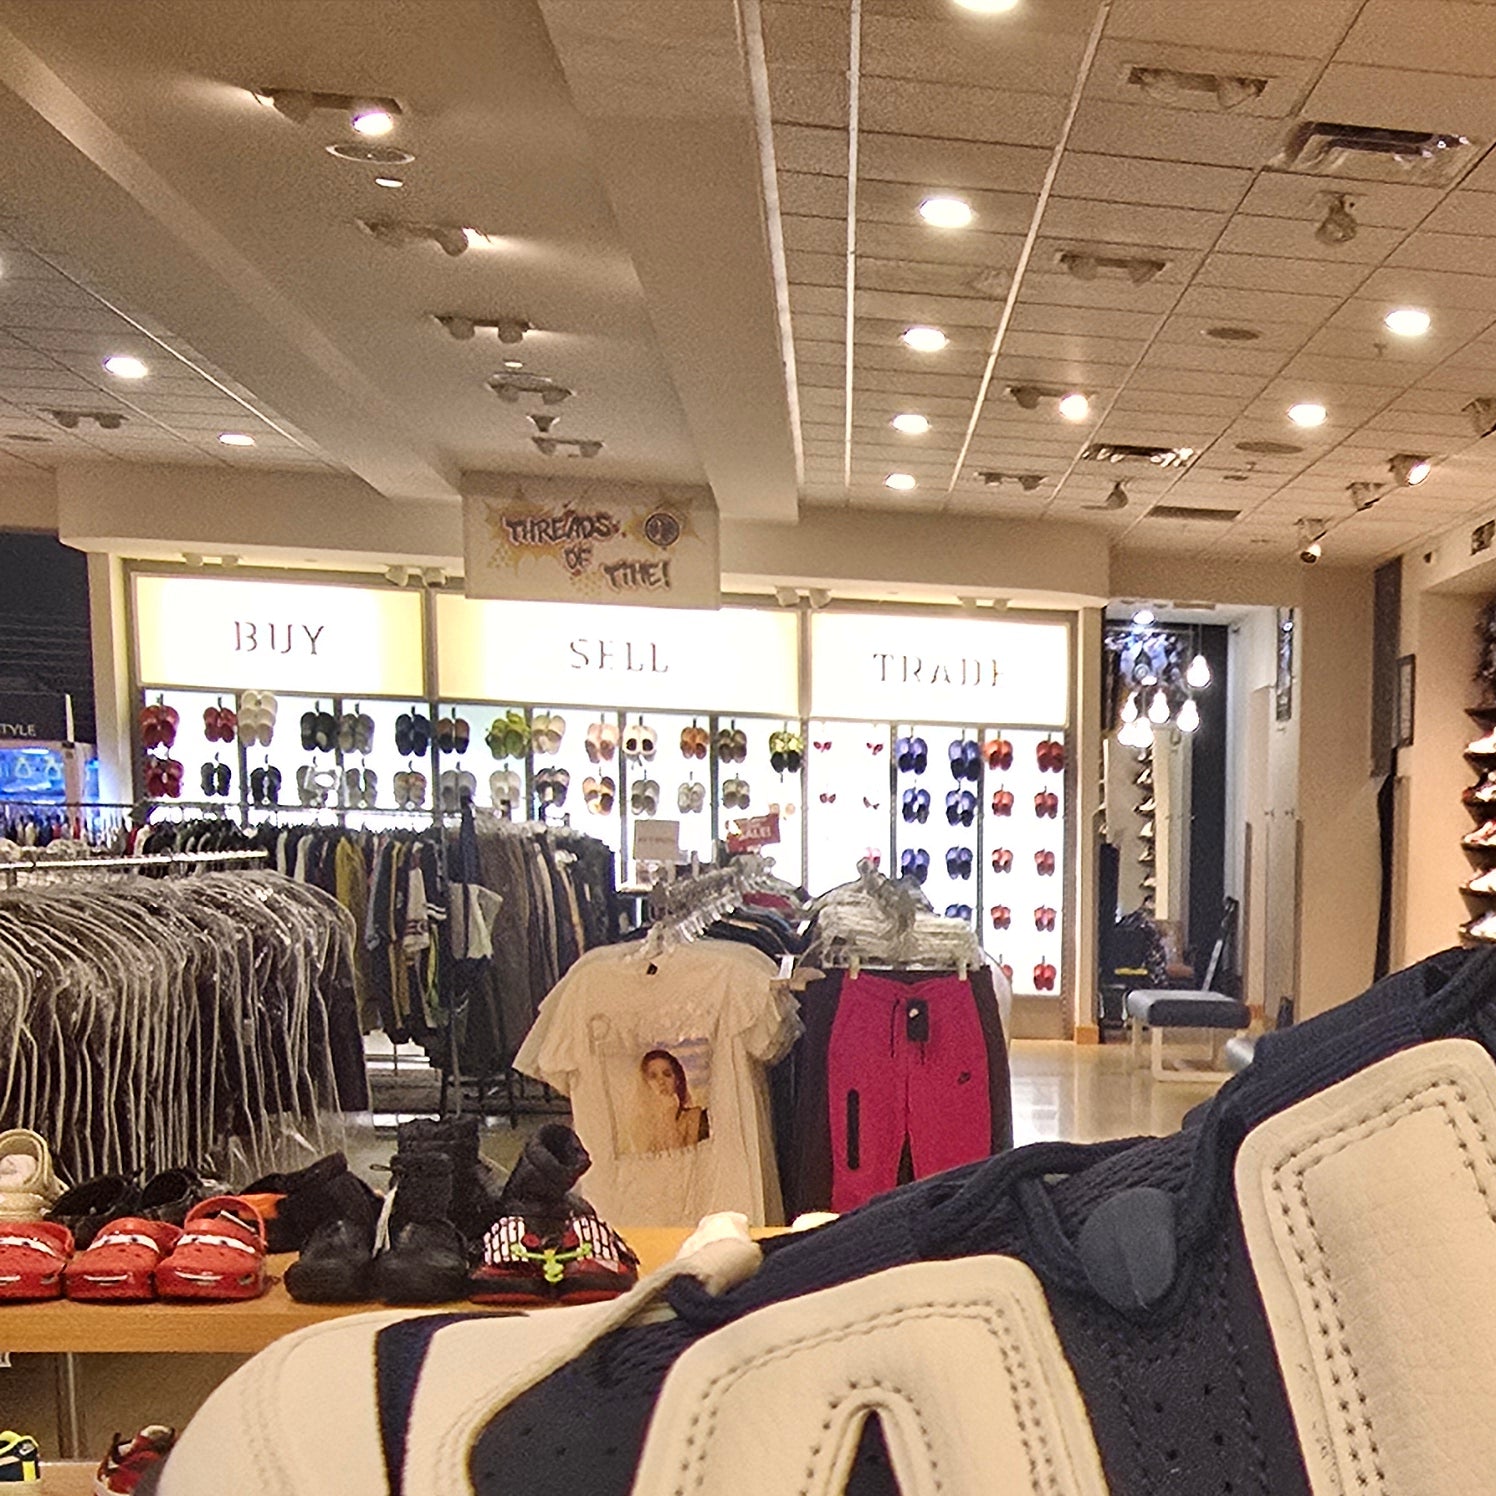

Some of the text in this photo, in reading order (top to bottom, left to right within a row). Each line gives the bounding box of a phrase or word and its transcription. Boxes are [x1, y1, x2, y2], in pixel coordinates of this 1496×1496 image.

[564, 546, 592, 569] OF
[234, 621, 325, 655] BUY
[570, 638, 669, 672] SELL
